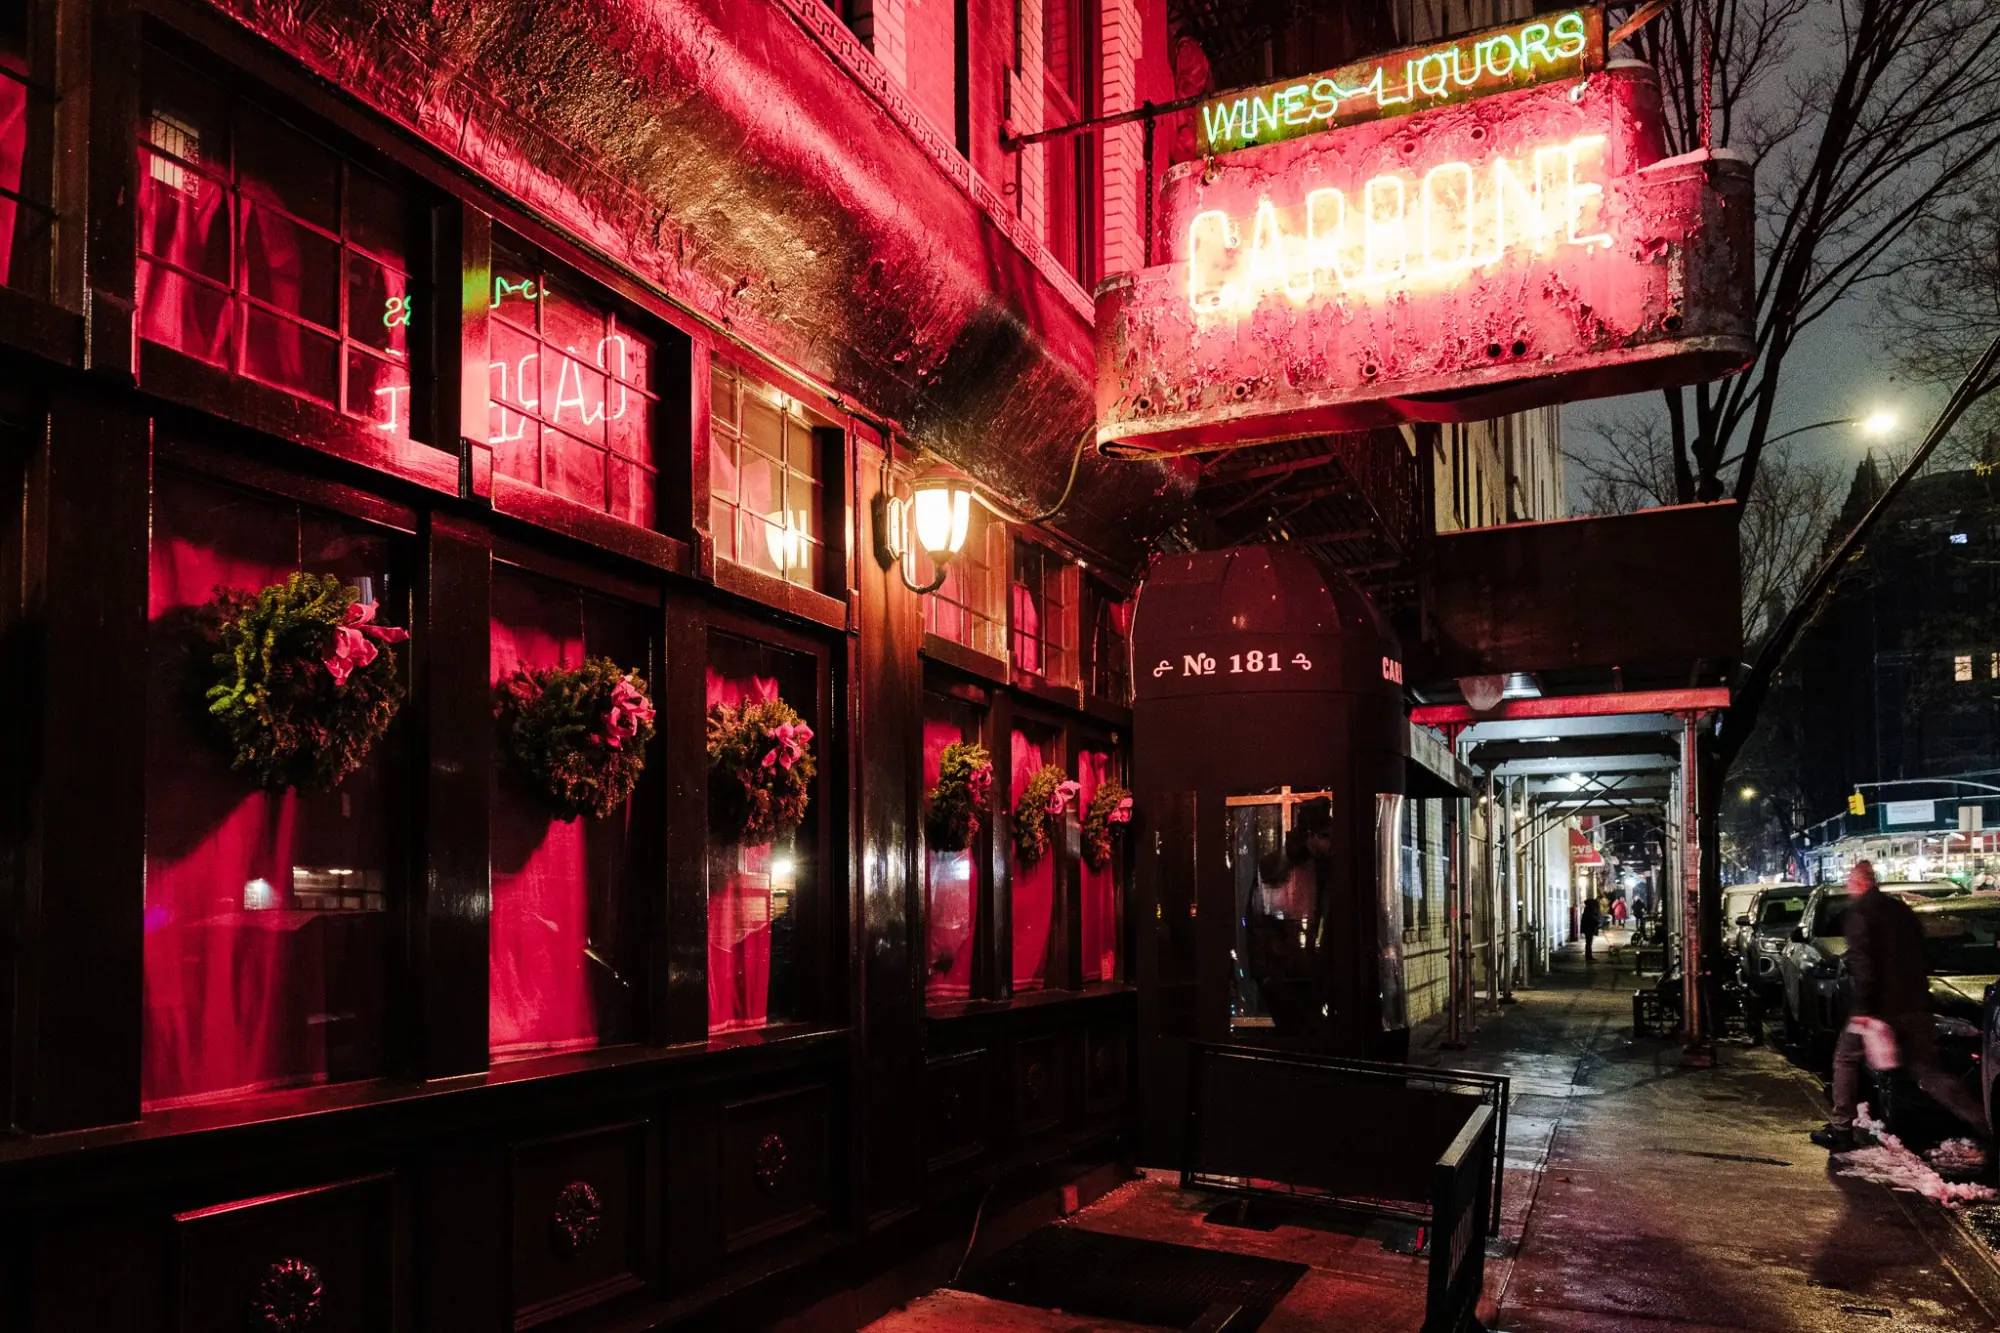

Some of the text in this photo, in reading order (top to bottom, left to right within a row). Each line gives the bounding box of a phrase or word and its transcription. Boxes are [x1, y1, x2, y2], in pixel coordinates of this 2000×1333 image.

[1203, 14, 1587, 143] WINES LIQUORS
[1190, 135, 1614, 314] CARBONE
[1229, 650, 1281, 673] 181
[1571, 845, 1592, 854] CVS
